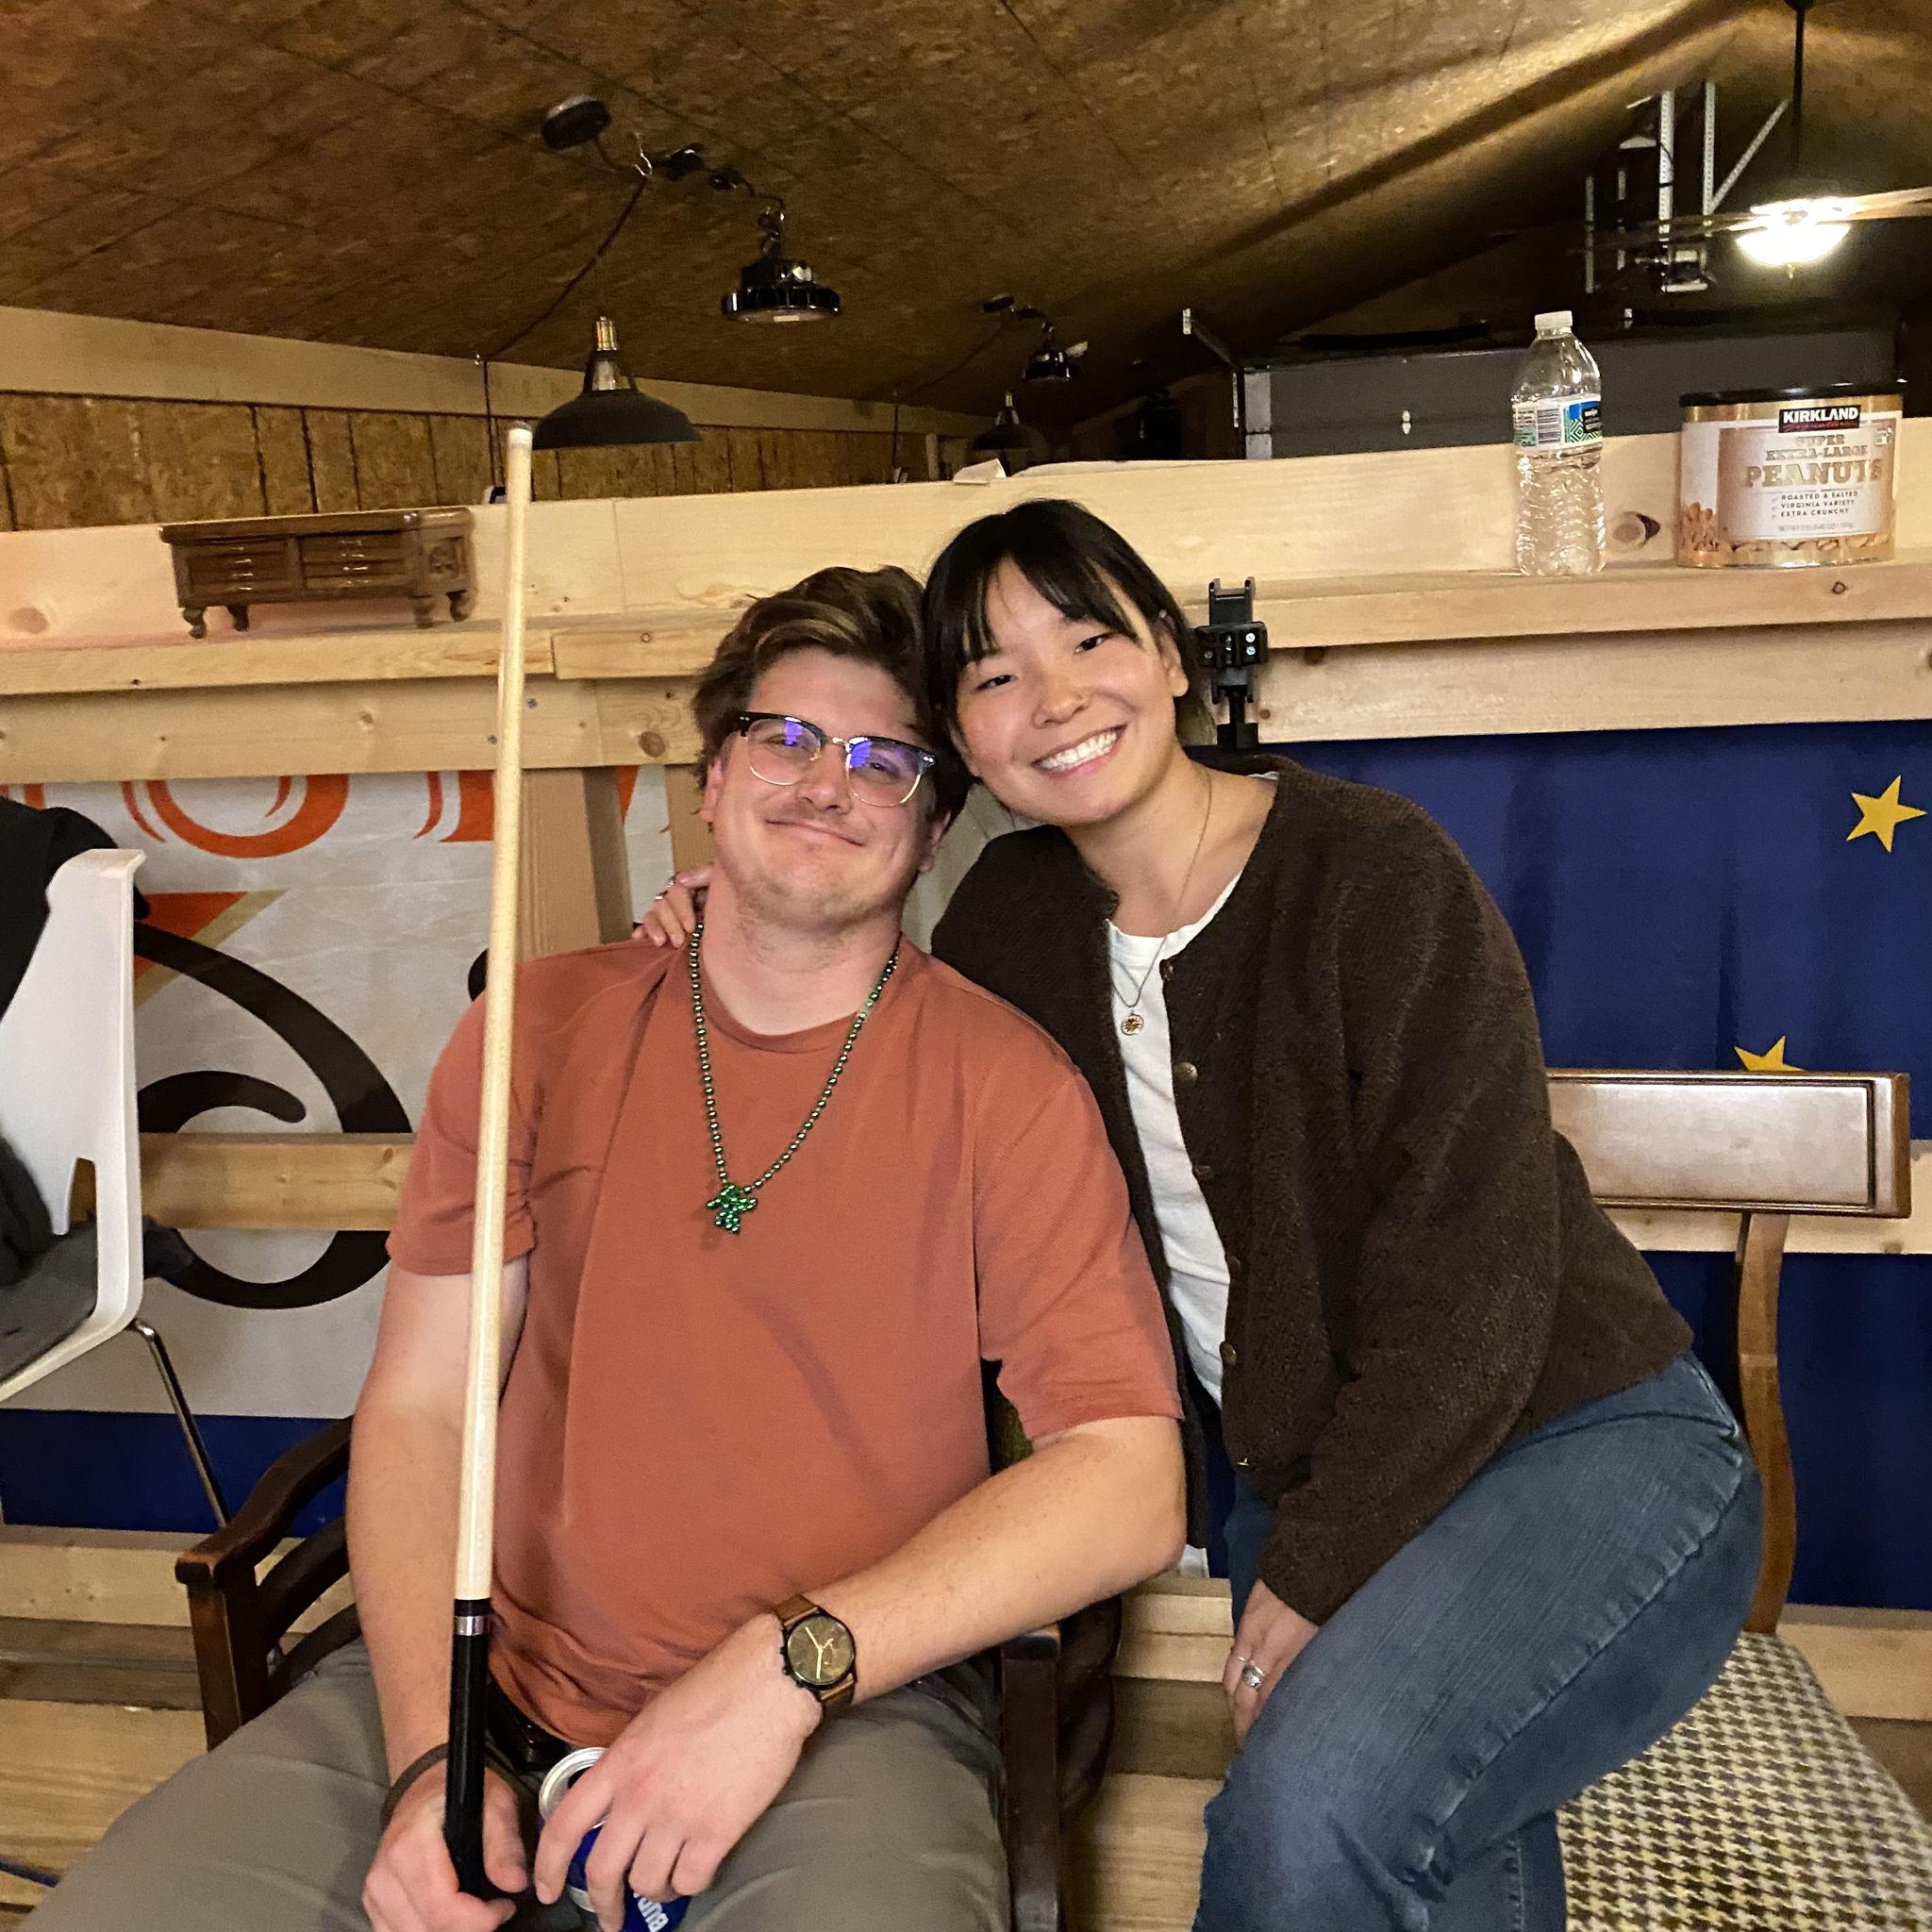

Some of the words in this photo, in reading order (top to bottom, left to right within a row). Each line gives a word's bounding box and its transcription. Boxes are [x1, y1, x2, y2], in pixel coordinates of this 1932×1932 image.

[1783, 408, 1858, 424] KIRKLAND
[1796, 434, 1845, 446] SUPER
[1766, 445, 1868, 460] EXTRA-LARGE
[1746, 458, 1883, 488] PEANUTS
